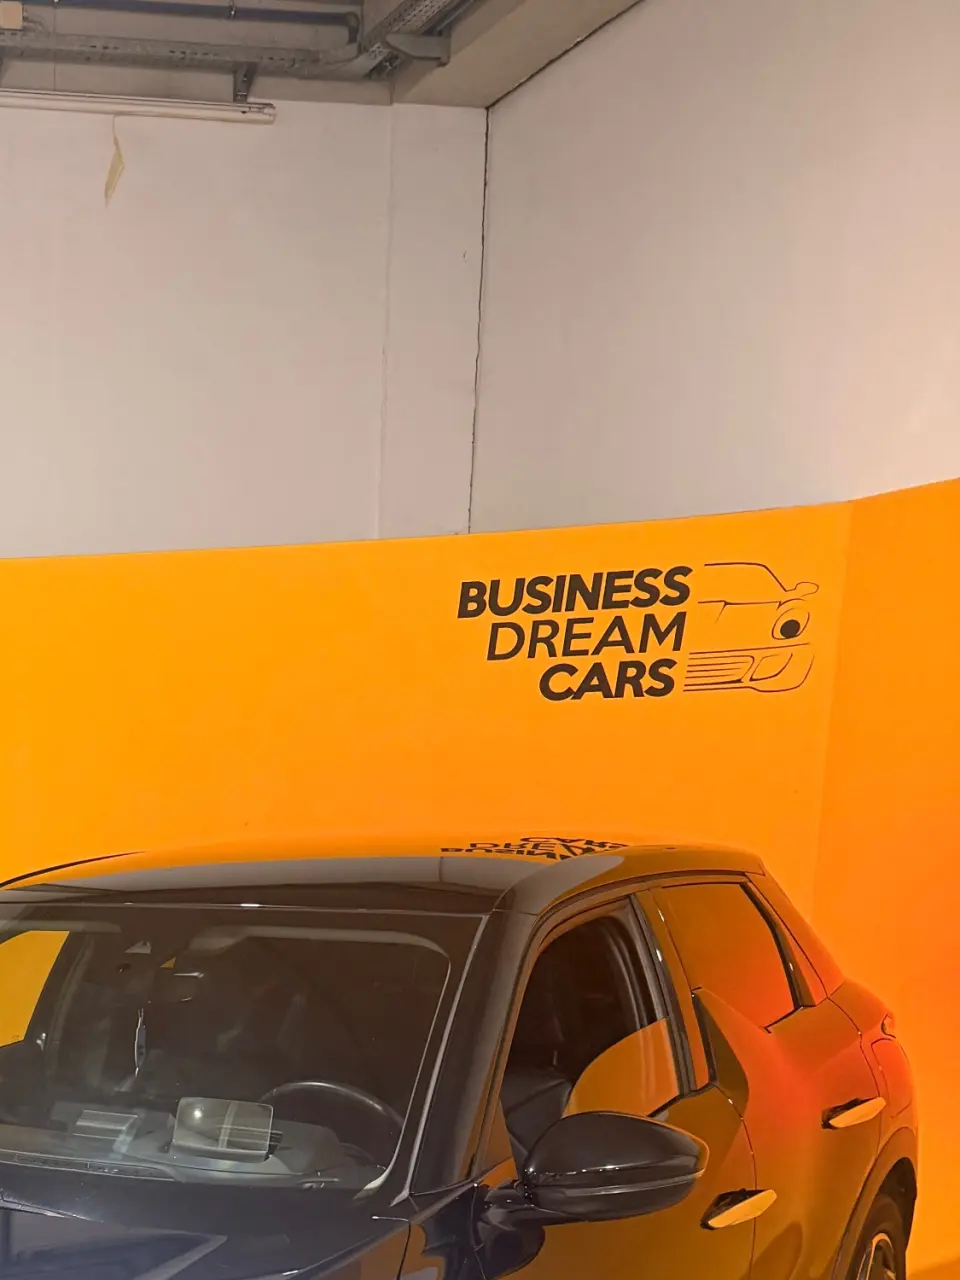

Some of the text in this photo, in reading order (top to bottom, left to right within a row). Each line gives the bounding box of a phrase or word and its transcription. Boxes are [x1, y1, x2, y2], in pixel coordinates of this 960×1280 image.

[457, 565, 694, 619] BUSINESS
[486, 611, 687, 661] DREAM
[539, 658, 678, 702] CARS
